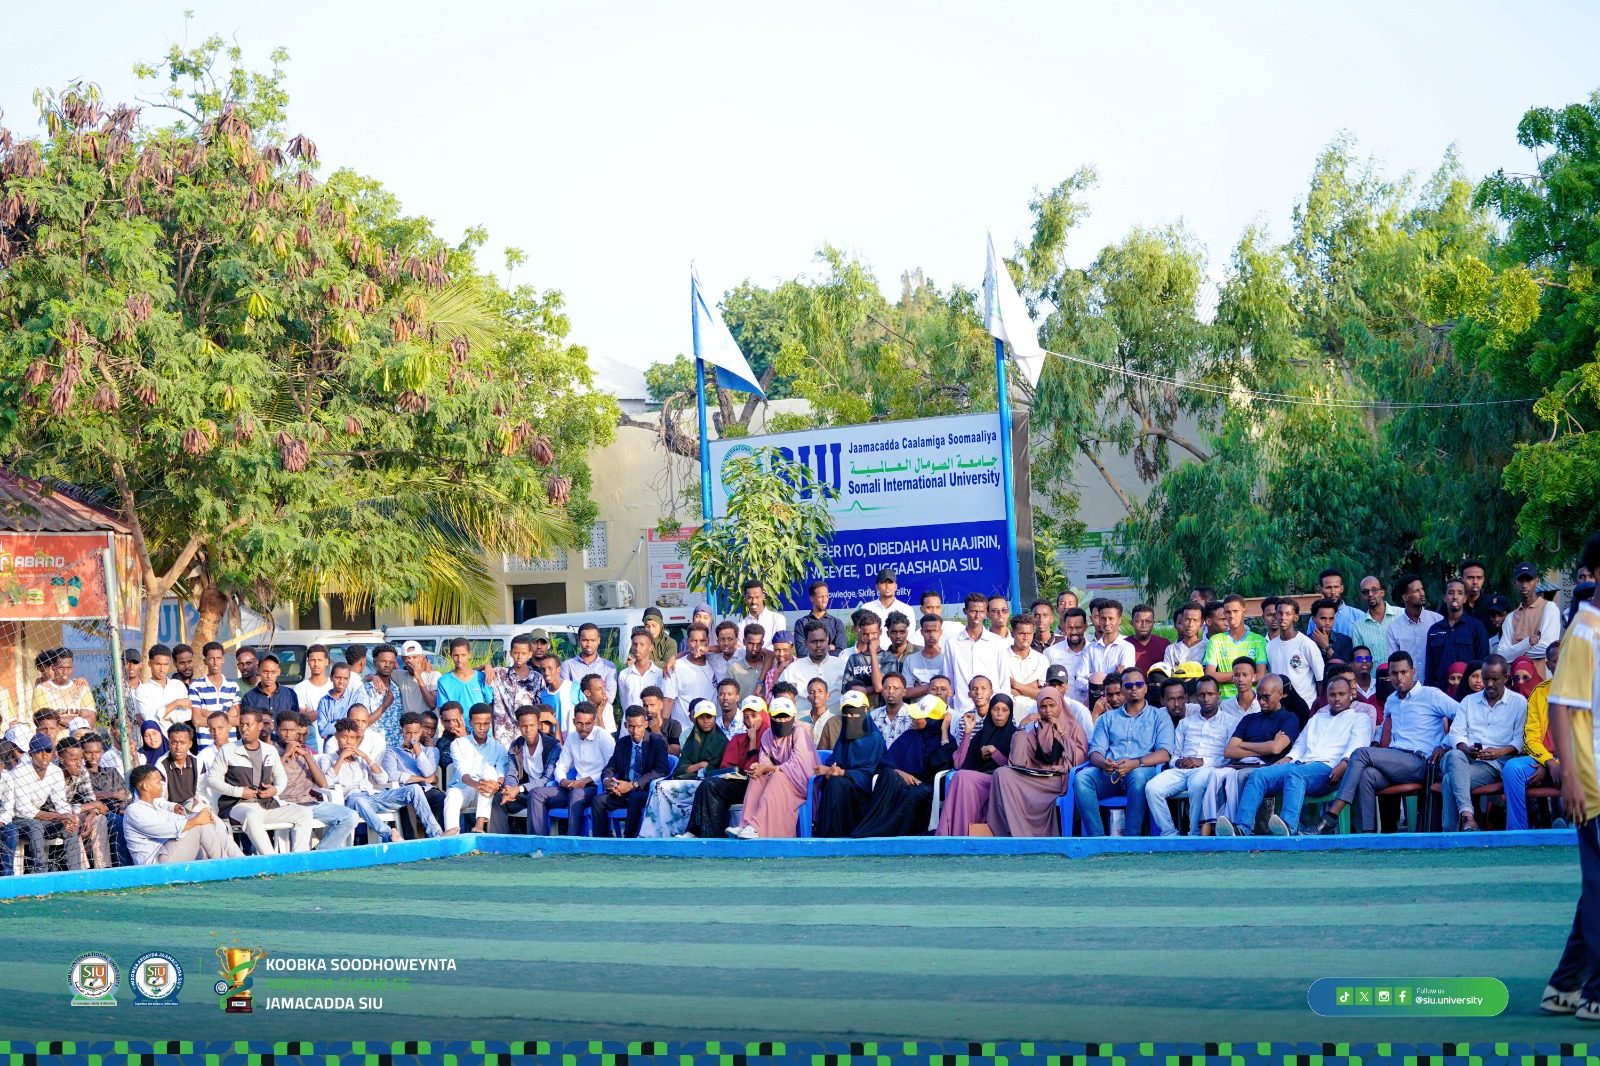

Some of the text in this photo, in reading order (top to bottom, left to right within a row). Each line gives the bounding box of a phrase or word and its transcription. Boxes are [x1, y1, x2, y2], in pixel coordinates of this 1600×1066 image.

[848, 430, 997, 454] Jaamacadda Caalamiga Soomaaliya
[914, 457, 953, 475] الصومال
[956, 454, 998, 470] جامعة
[848, 469, 1001, 495] Somali International University
[843, 543, 867, 558] IYO,
[868, 540, 929, 556] DIBEDAHA
[931, 538, 940, 552] U
[942, 534, 1001, 551] HAAJIRIN,
[959, 557, 983, 572] SIU.
[828, 589, 857, 600] owledge,
